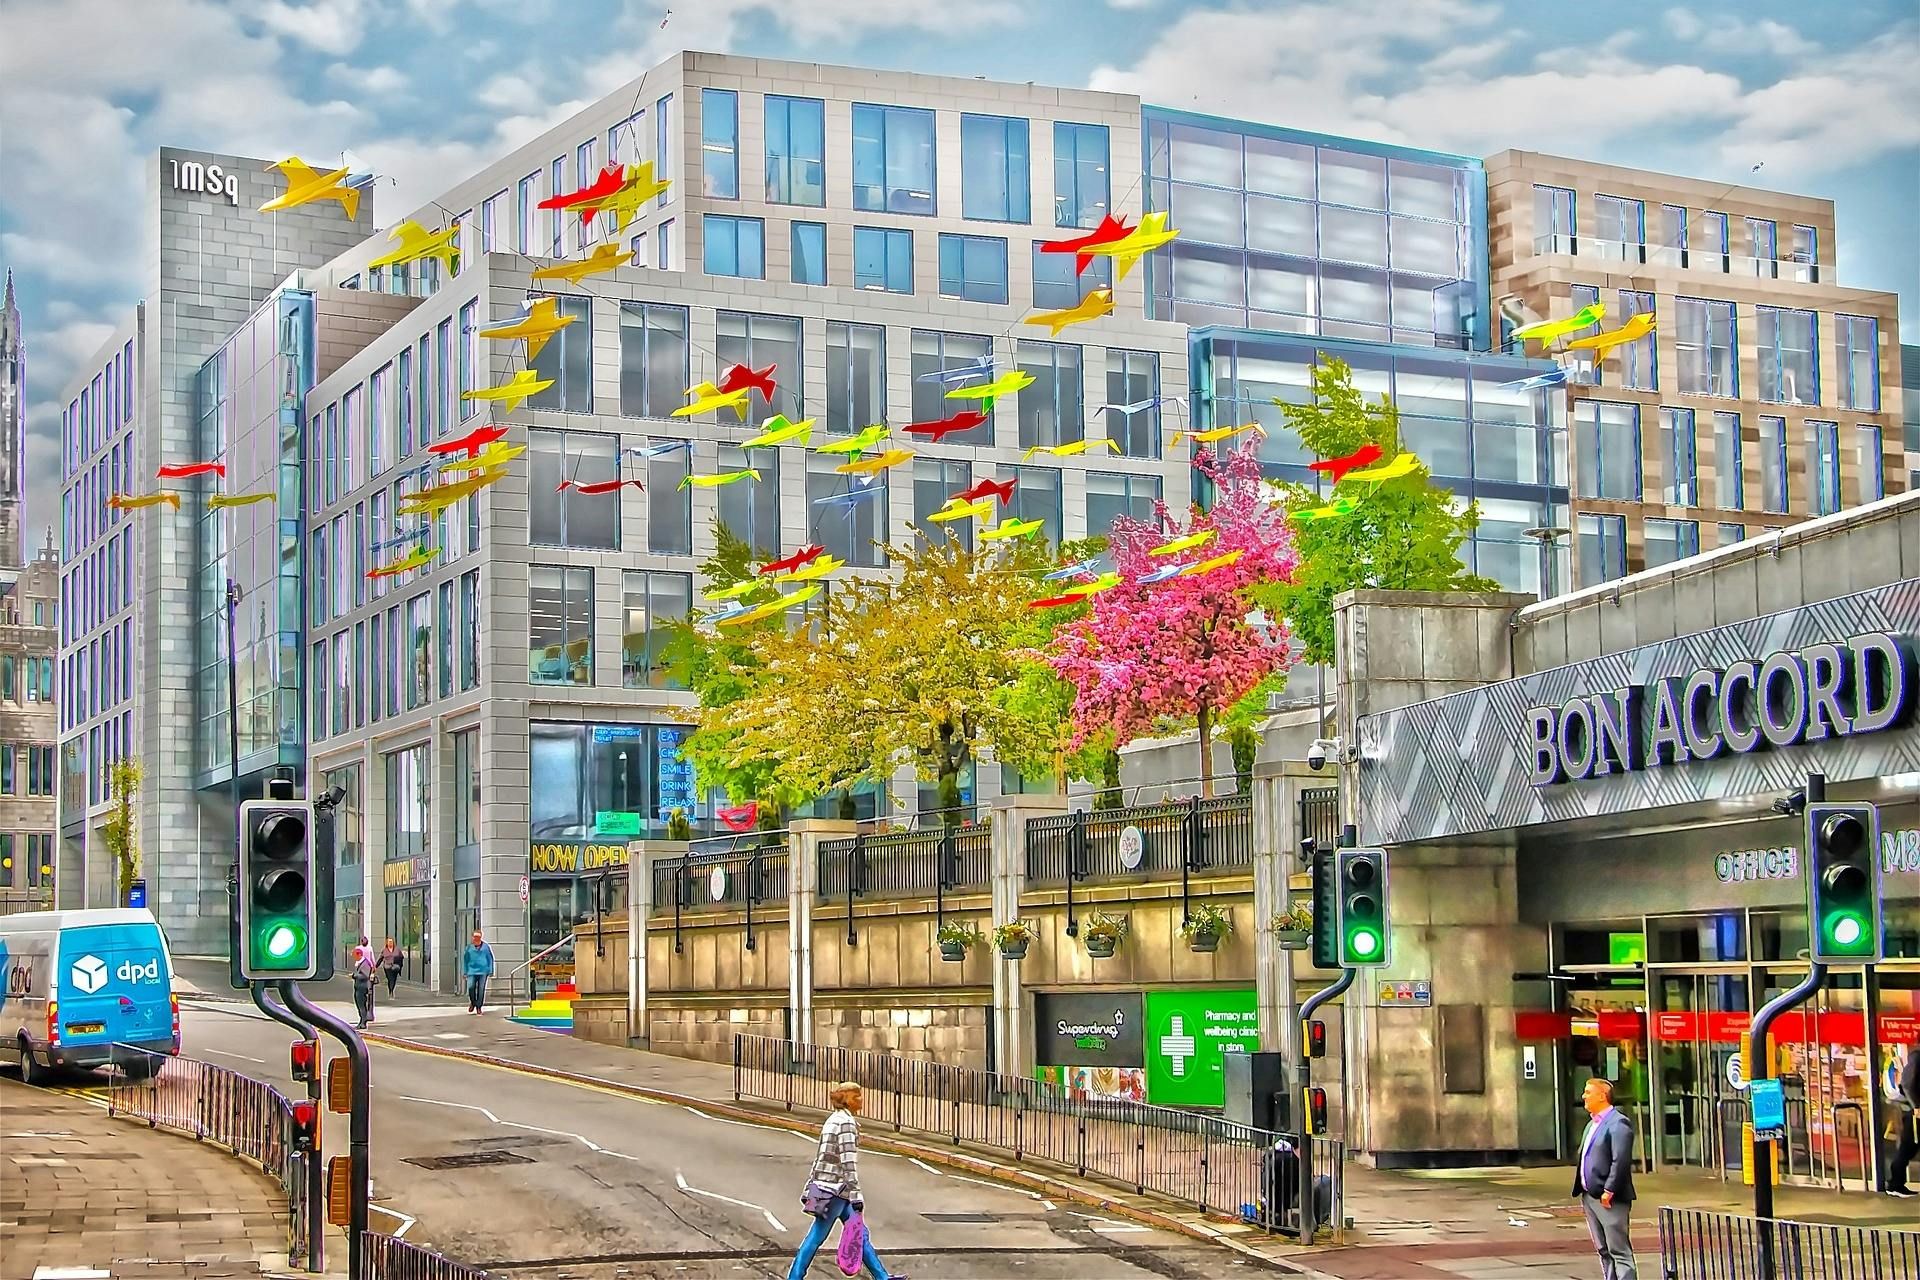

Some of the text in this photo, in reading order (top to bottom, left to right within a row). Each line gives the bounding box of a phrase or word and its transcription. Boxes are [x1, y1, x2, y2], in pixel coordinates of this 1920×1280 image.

[1527, 630, 1910, 787] BON ACCORD
[661, 732, 680, 741] EAT
[661, 748, 685, 759] CHA
[661, 765, 691, 774] SMILE
[661, 781, 691, 791] DRINK
[661, 797, 696, 807] RELAX
[532, 844, 629, 872] NOW OPEN
[1715, 846, 1798, 883] OFFICE
[116, 958, 158, 984] dpd
[1204, 1009, 1256, 1023] Pharmacy and
[1057, 1020, 1119, 1039] Superdrug
[1203, 1026, 1258, 1039] wellbeing clinic
[1217, 1041, 1245, 1052] in store
